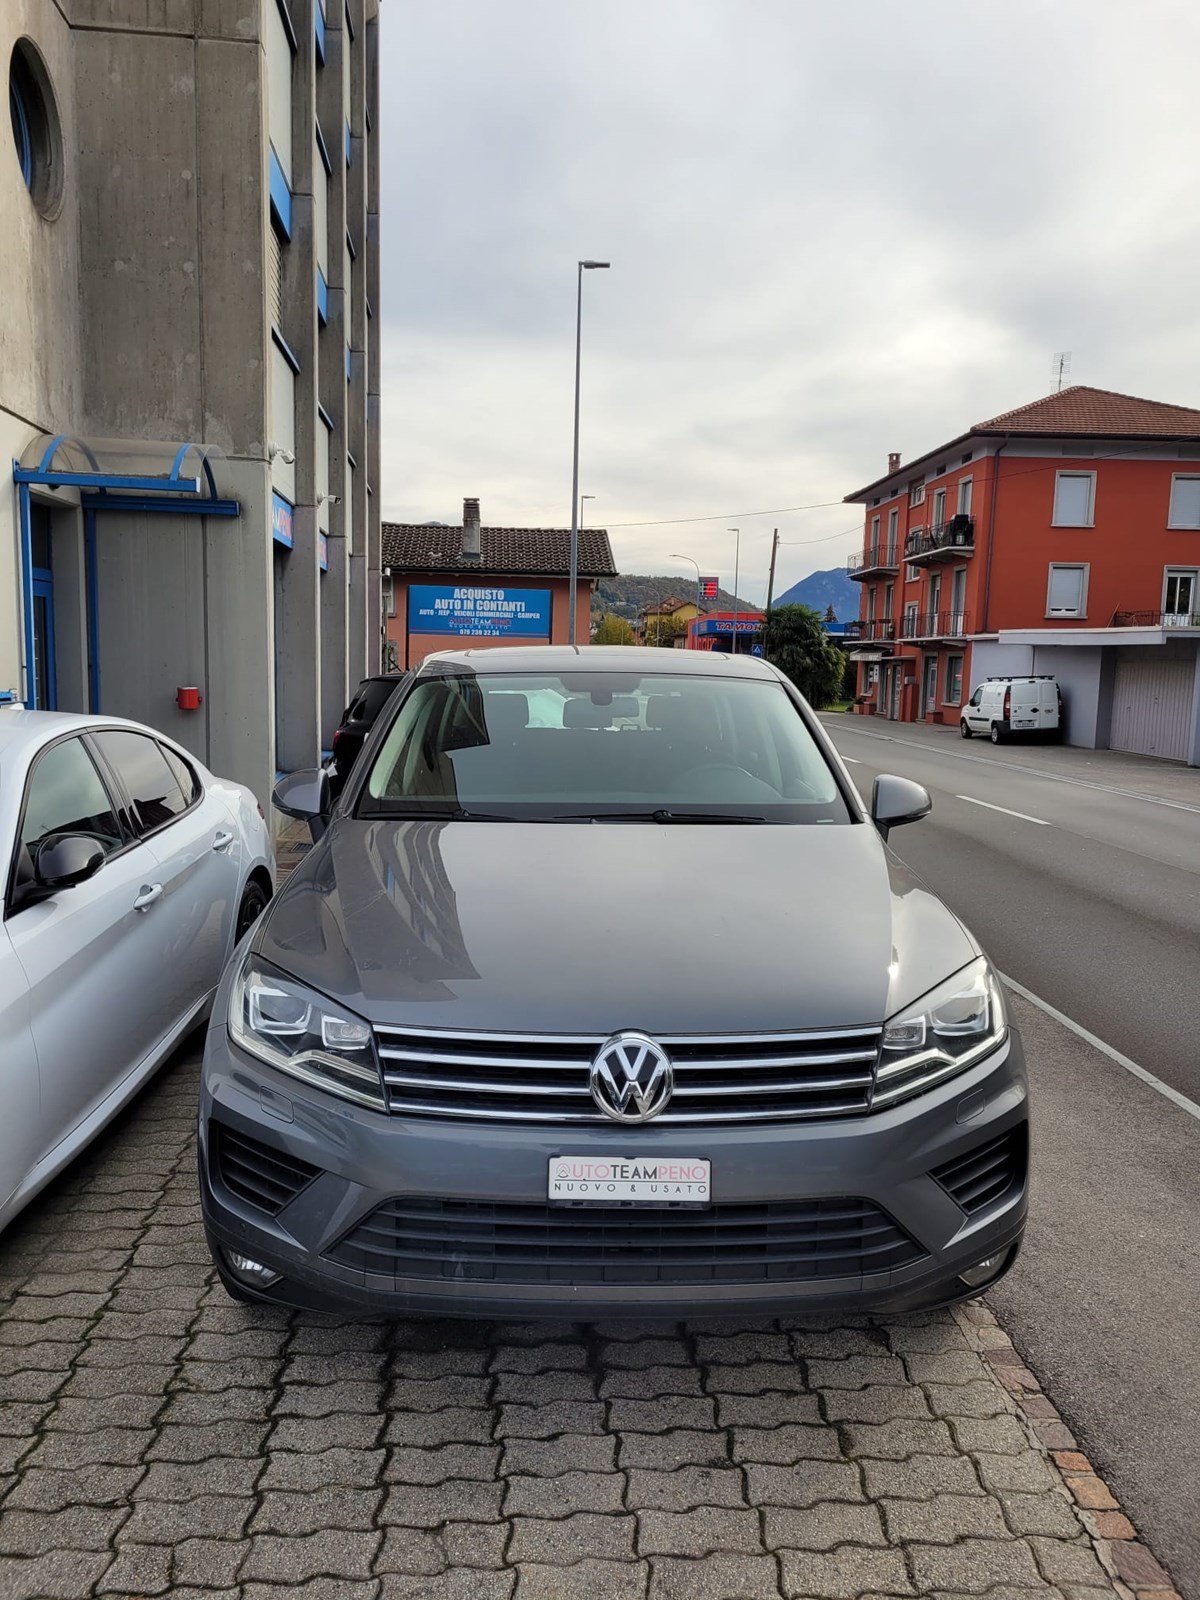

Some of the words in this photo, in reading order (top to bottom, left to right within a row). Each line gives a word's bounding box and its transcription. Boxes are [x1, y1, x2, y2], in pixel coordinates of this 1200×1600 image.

[453, 588, 505, 601] ACQUISTO
[434, 599, 461, 610] AUTO
[463, 600, 474, 611] IN
[476, 600, 525, 612] CONTANTI
[475, 610, 514, 618] COMMERCIALI
[555, 1183, 616, 1193] NUOVO
[630, 1184, 637, 1193] &
[651, 1184, 707, 1194] USATO
